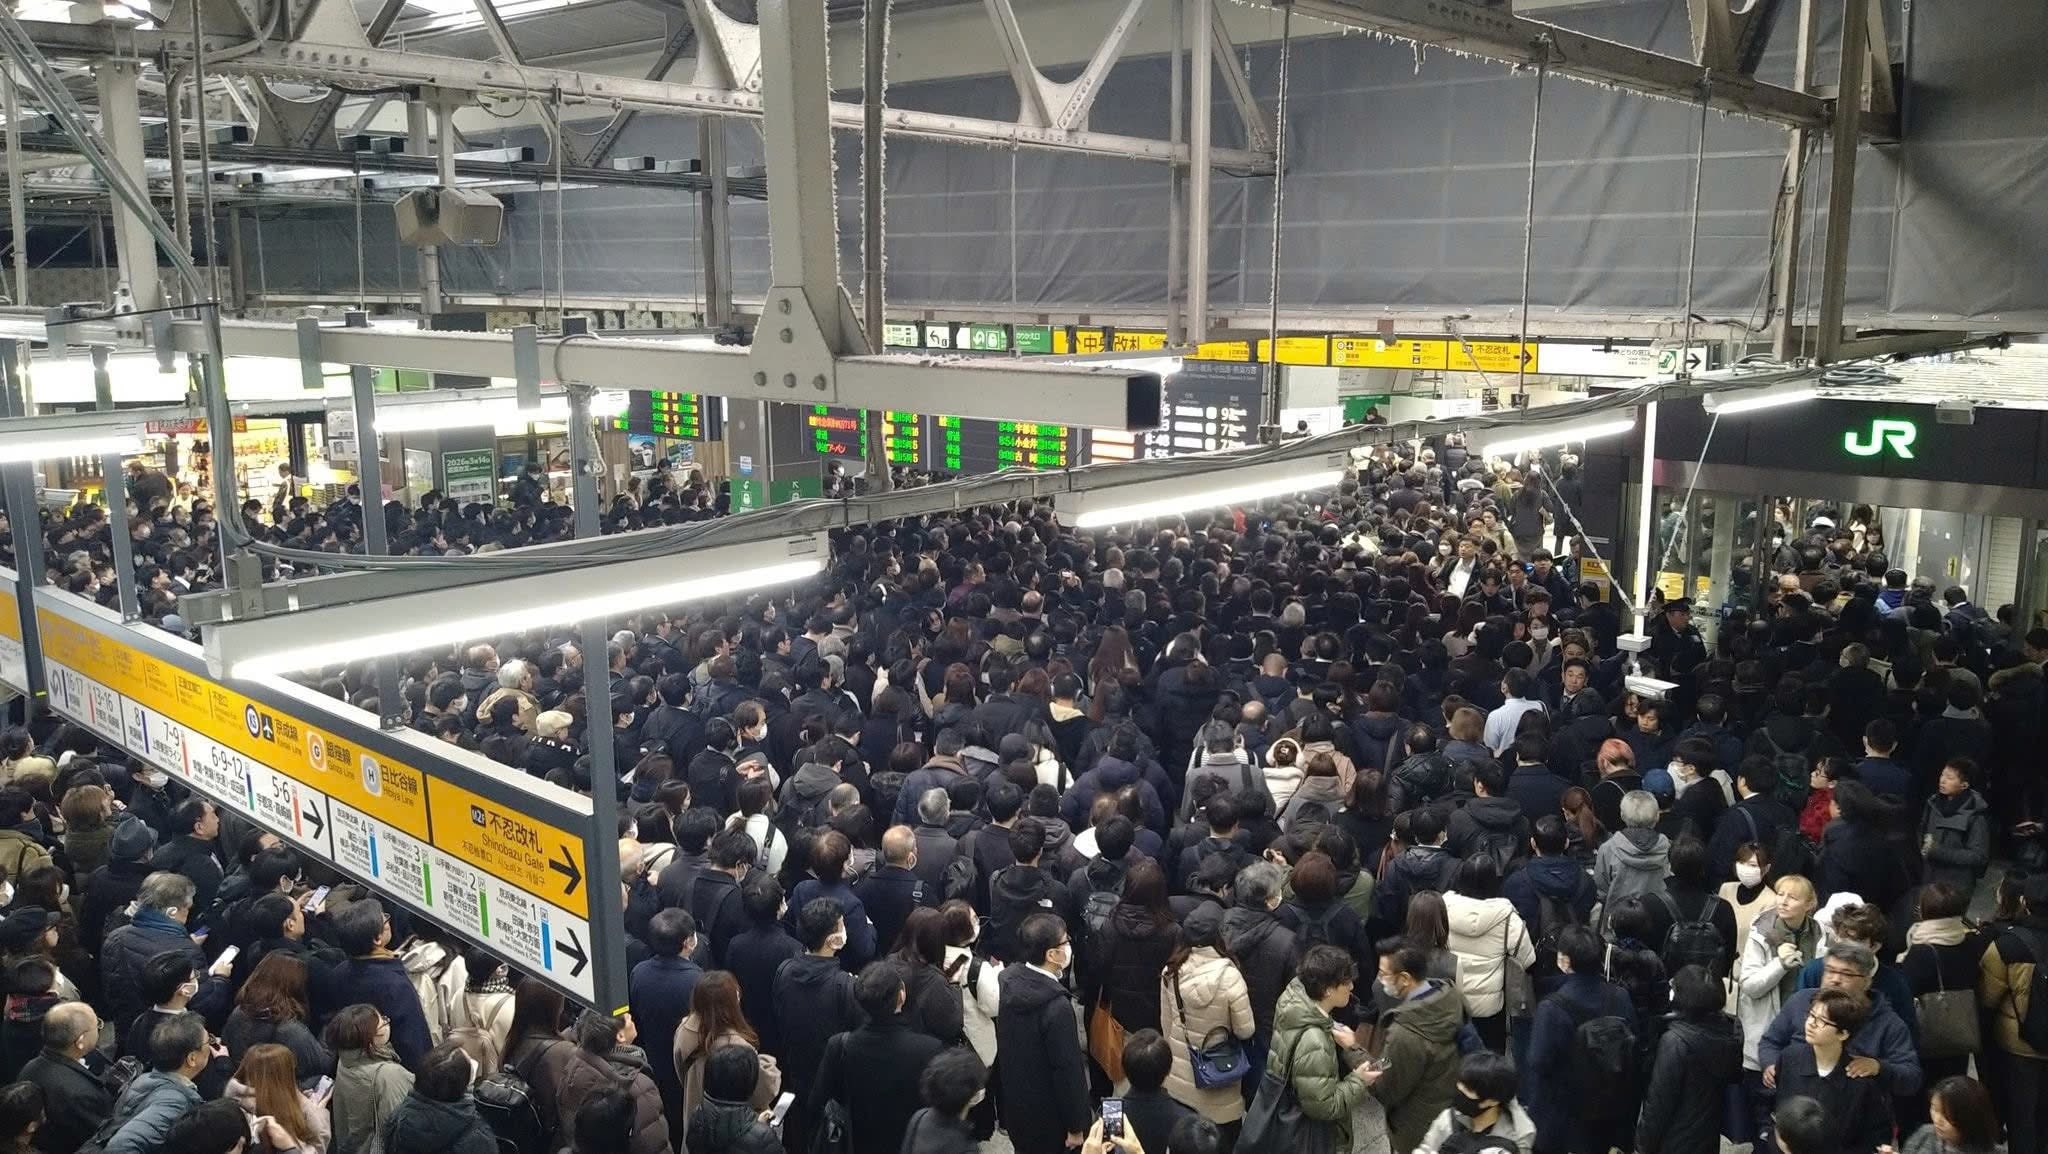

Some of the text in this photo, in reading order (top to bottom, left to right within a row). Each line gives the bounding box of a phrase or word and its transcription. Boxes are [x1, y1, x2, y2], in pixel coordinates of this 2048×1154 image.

[1475, 344, 1511, 354] 不忍改札
[1015, 436, 1038, 449] 小金井
[1060, 441, 1067, 452] 5
[1845, 420, 1916, 458] JR
[447, 456, 490, 467] 2026年3月14日
[1060, 455, 1066, 466] 5
[133, 705, 141, 727] 8
[313, 744, 320, 758] G
[325, 740, 351, 767] 銀座線
[368, 769, 374, 782] H
[380, 763, 418, 797] 日比谷線
[360, 818, 367, 836] 4
[487, 809, 543, 855] 不忍改札
[413, 844, 420, 863] 3
[481, 832, 544, 873] Shinobazu Gate
[468, 871, 476, 891] 2
[530, 902, 536, 921] 1
